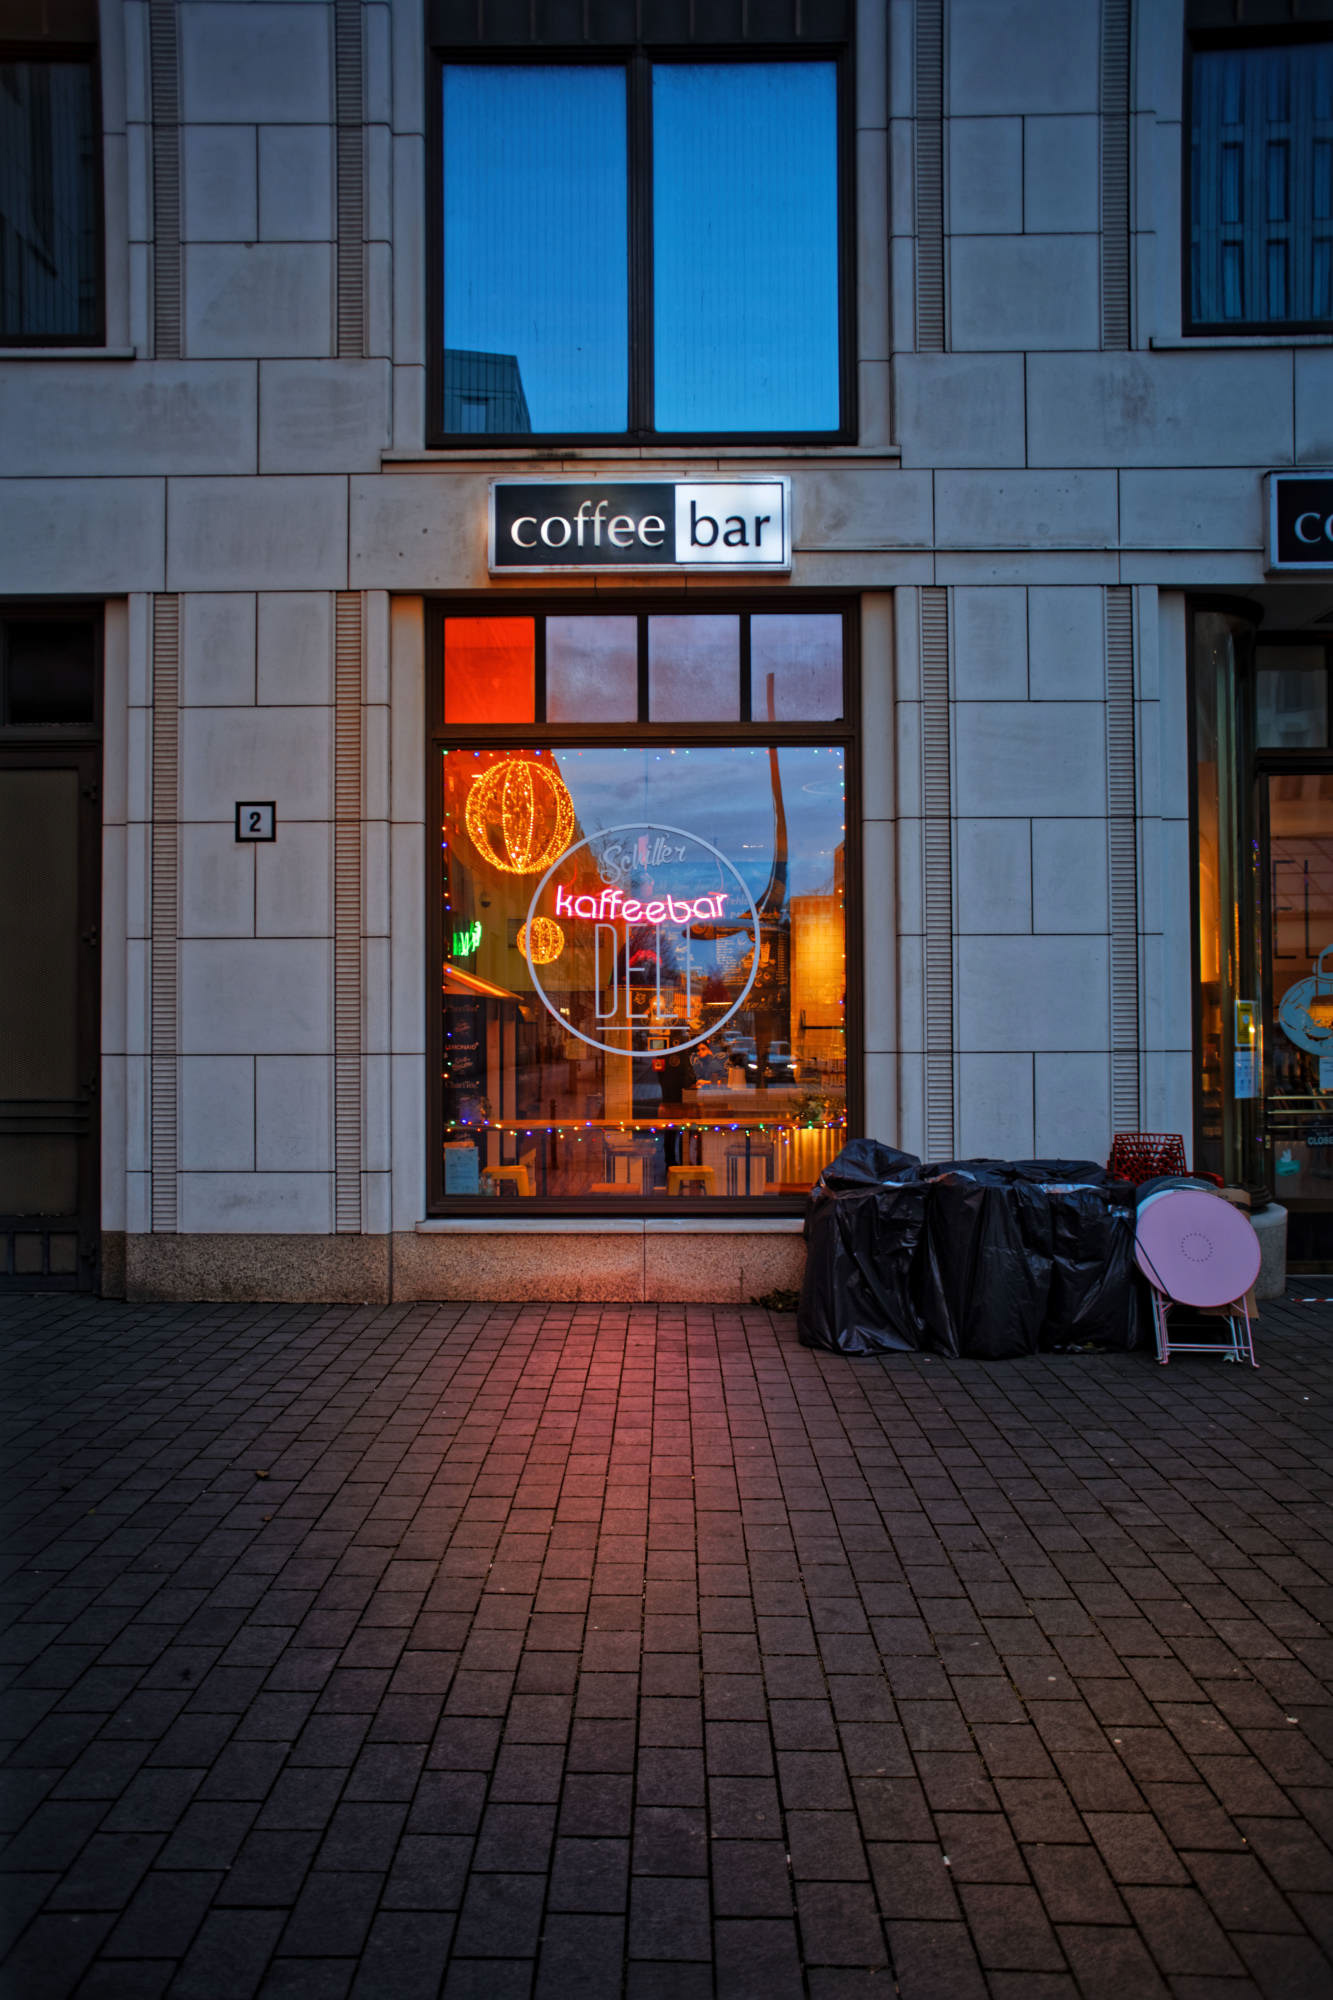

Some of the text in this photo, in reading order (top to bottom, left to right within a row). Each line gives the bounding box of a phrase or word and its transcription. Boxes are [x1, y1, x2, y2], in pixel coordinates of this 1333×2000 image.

[510, 499, 771, 548] coffee bar
[1295, 512, 1333, 543] c
[249, 811, 261, 832] 2
[555, 884, 729, 924] kaffeebar
[595, 923, 691, 1019] DELI
